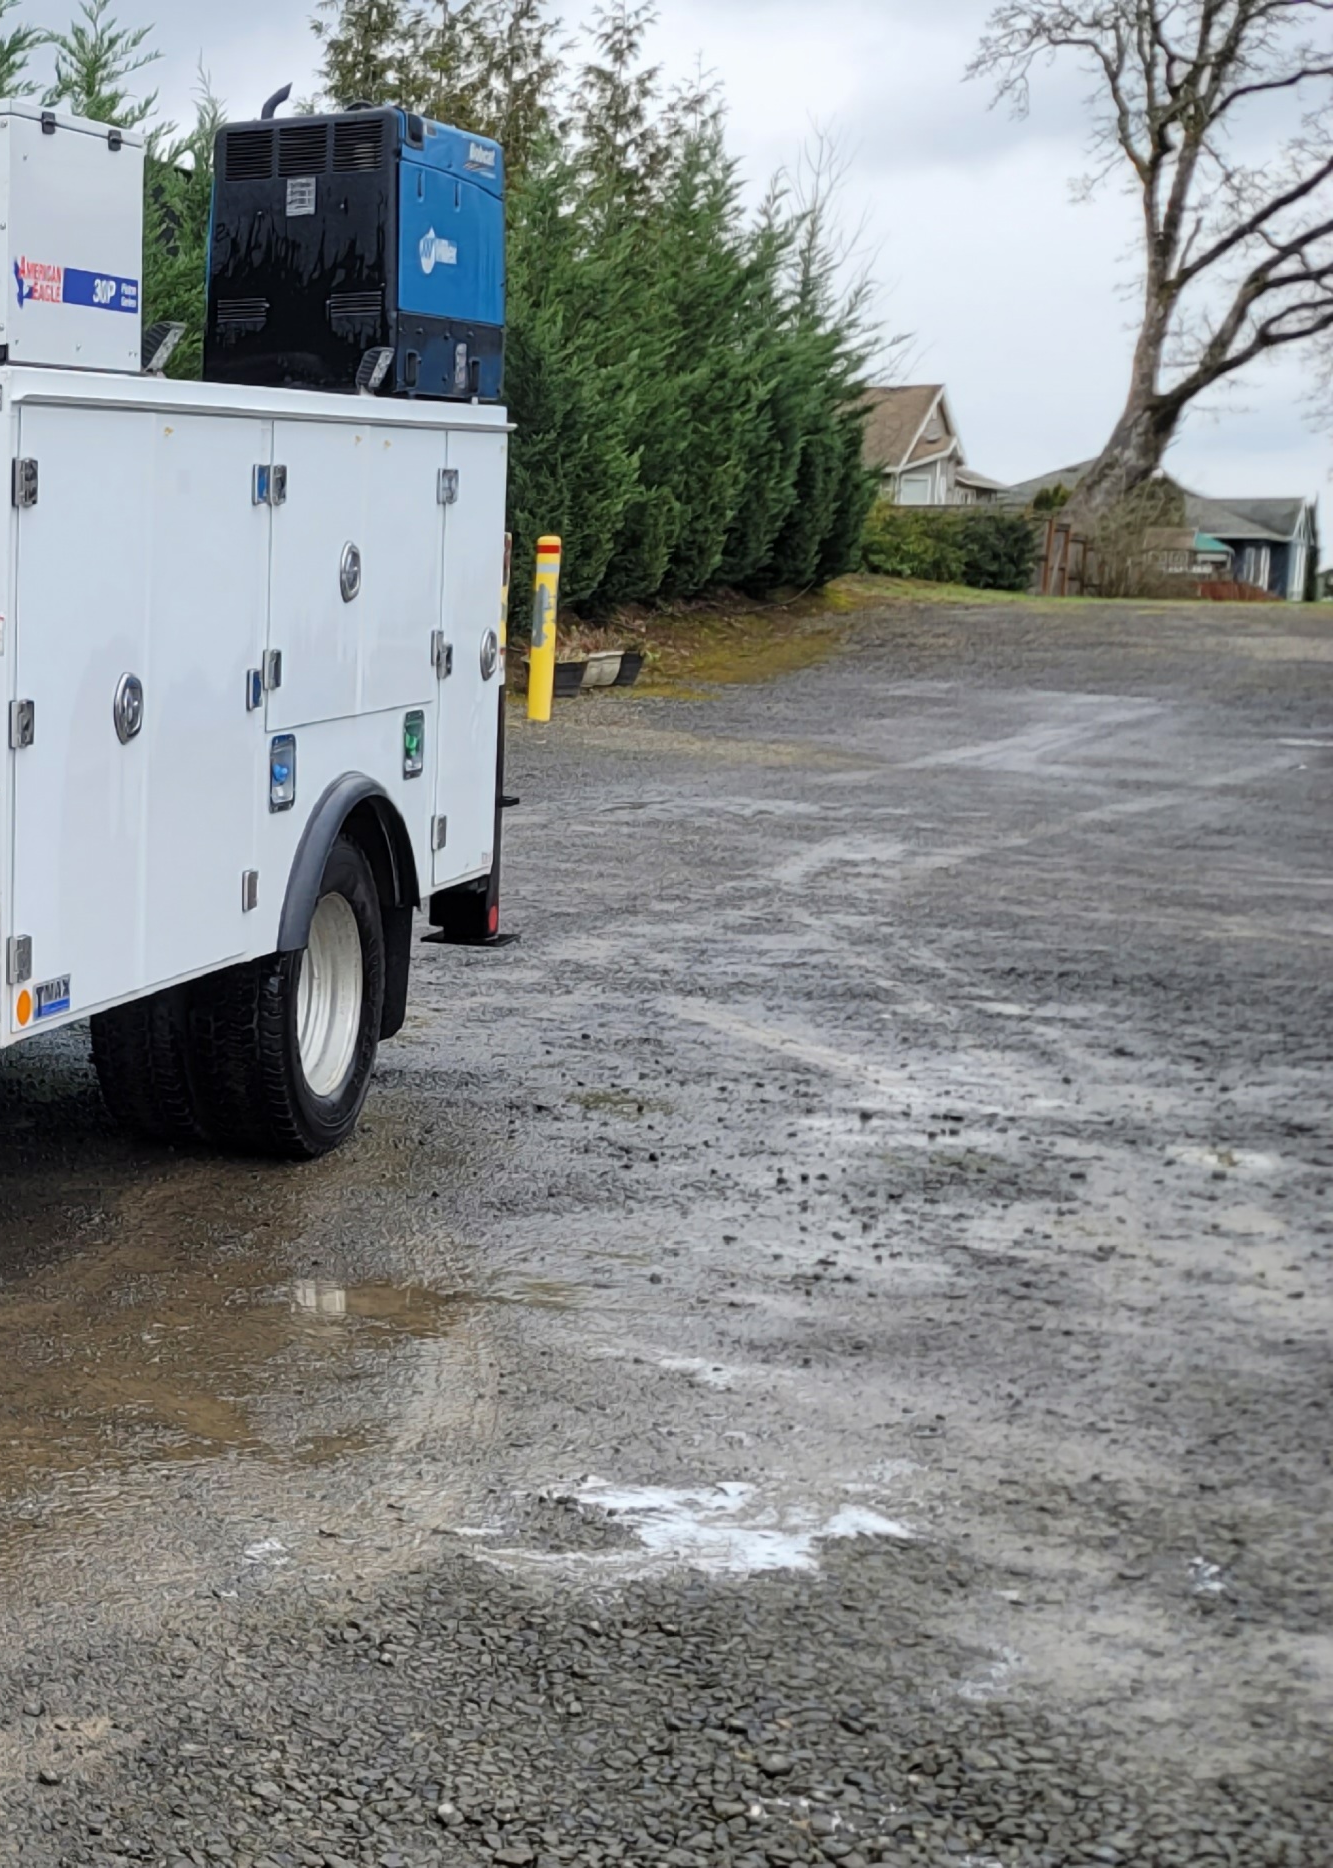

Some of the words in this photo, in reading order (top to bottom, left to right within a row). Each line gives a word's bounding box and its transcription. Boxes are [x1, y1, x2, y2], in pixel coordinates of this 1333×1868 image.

[18, 256, 61, 283] AMERICAN
[32, 282, 61, 303] EAGLE
[93, 278, 116, 304] 30P
